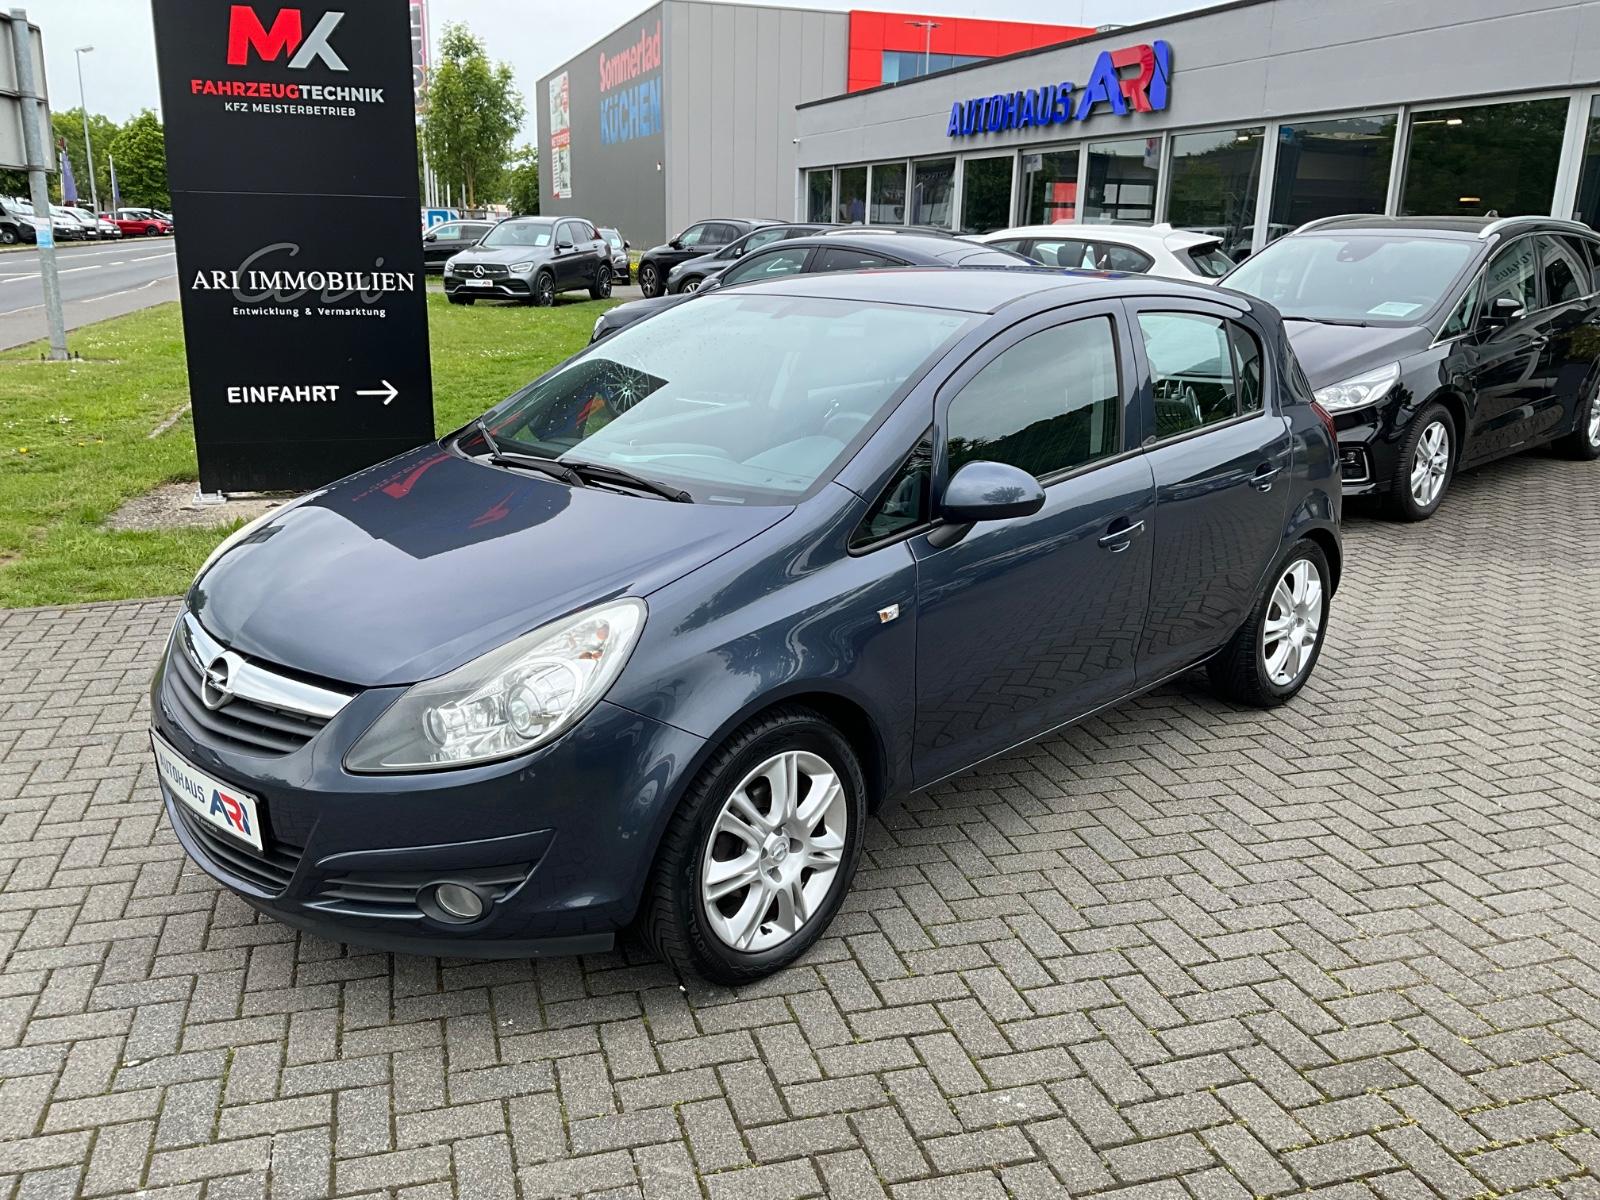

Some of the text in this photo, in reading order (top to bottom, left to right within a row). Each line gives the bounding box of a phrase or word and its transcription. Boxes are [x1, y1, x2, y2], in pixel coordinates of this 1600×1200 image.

[227, 5, 349, 71] MK
[599, 19, 661, 92] Sommerlad
[190, 79, 385, 103] FAHRZEUGTECHNIK
[224, 102, 356, 117] KFZ MEISTERBETRIEB
[600, 75, 661, 145] KÜCHEN
[947, 39, 1173, 137] AUTOHAUS ARI
[191, 270, 414, 292] ARI IMMOBILIEN
[232, 306, 386, 318] Entwicklung & Vermarktung
[227, 385, 340, 403] EINFAHRT
[159, 752, 205, 804] AUTOHAUS
[209, 788, 251, 836] ARI
